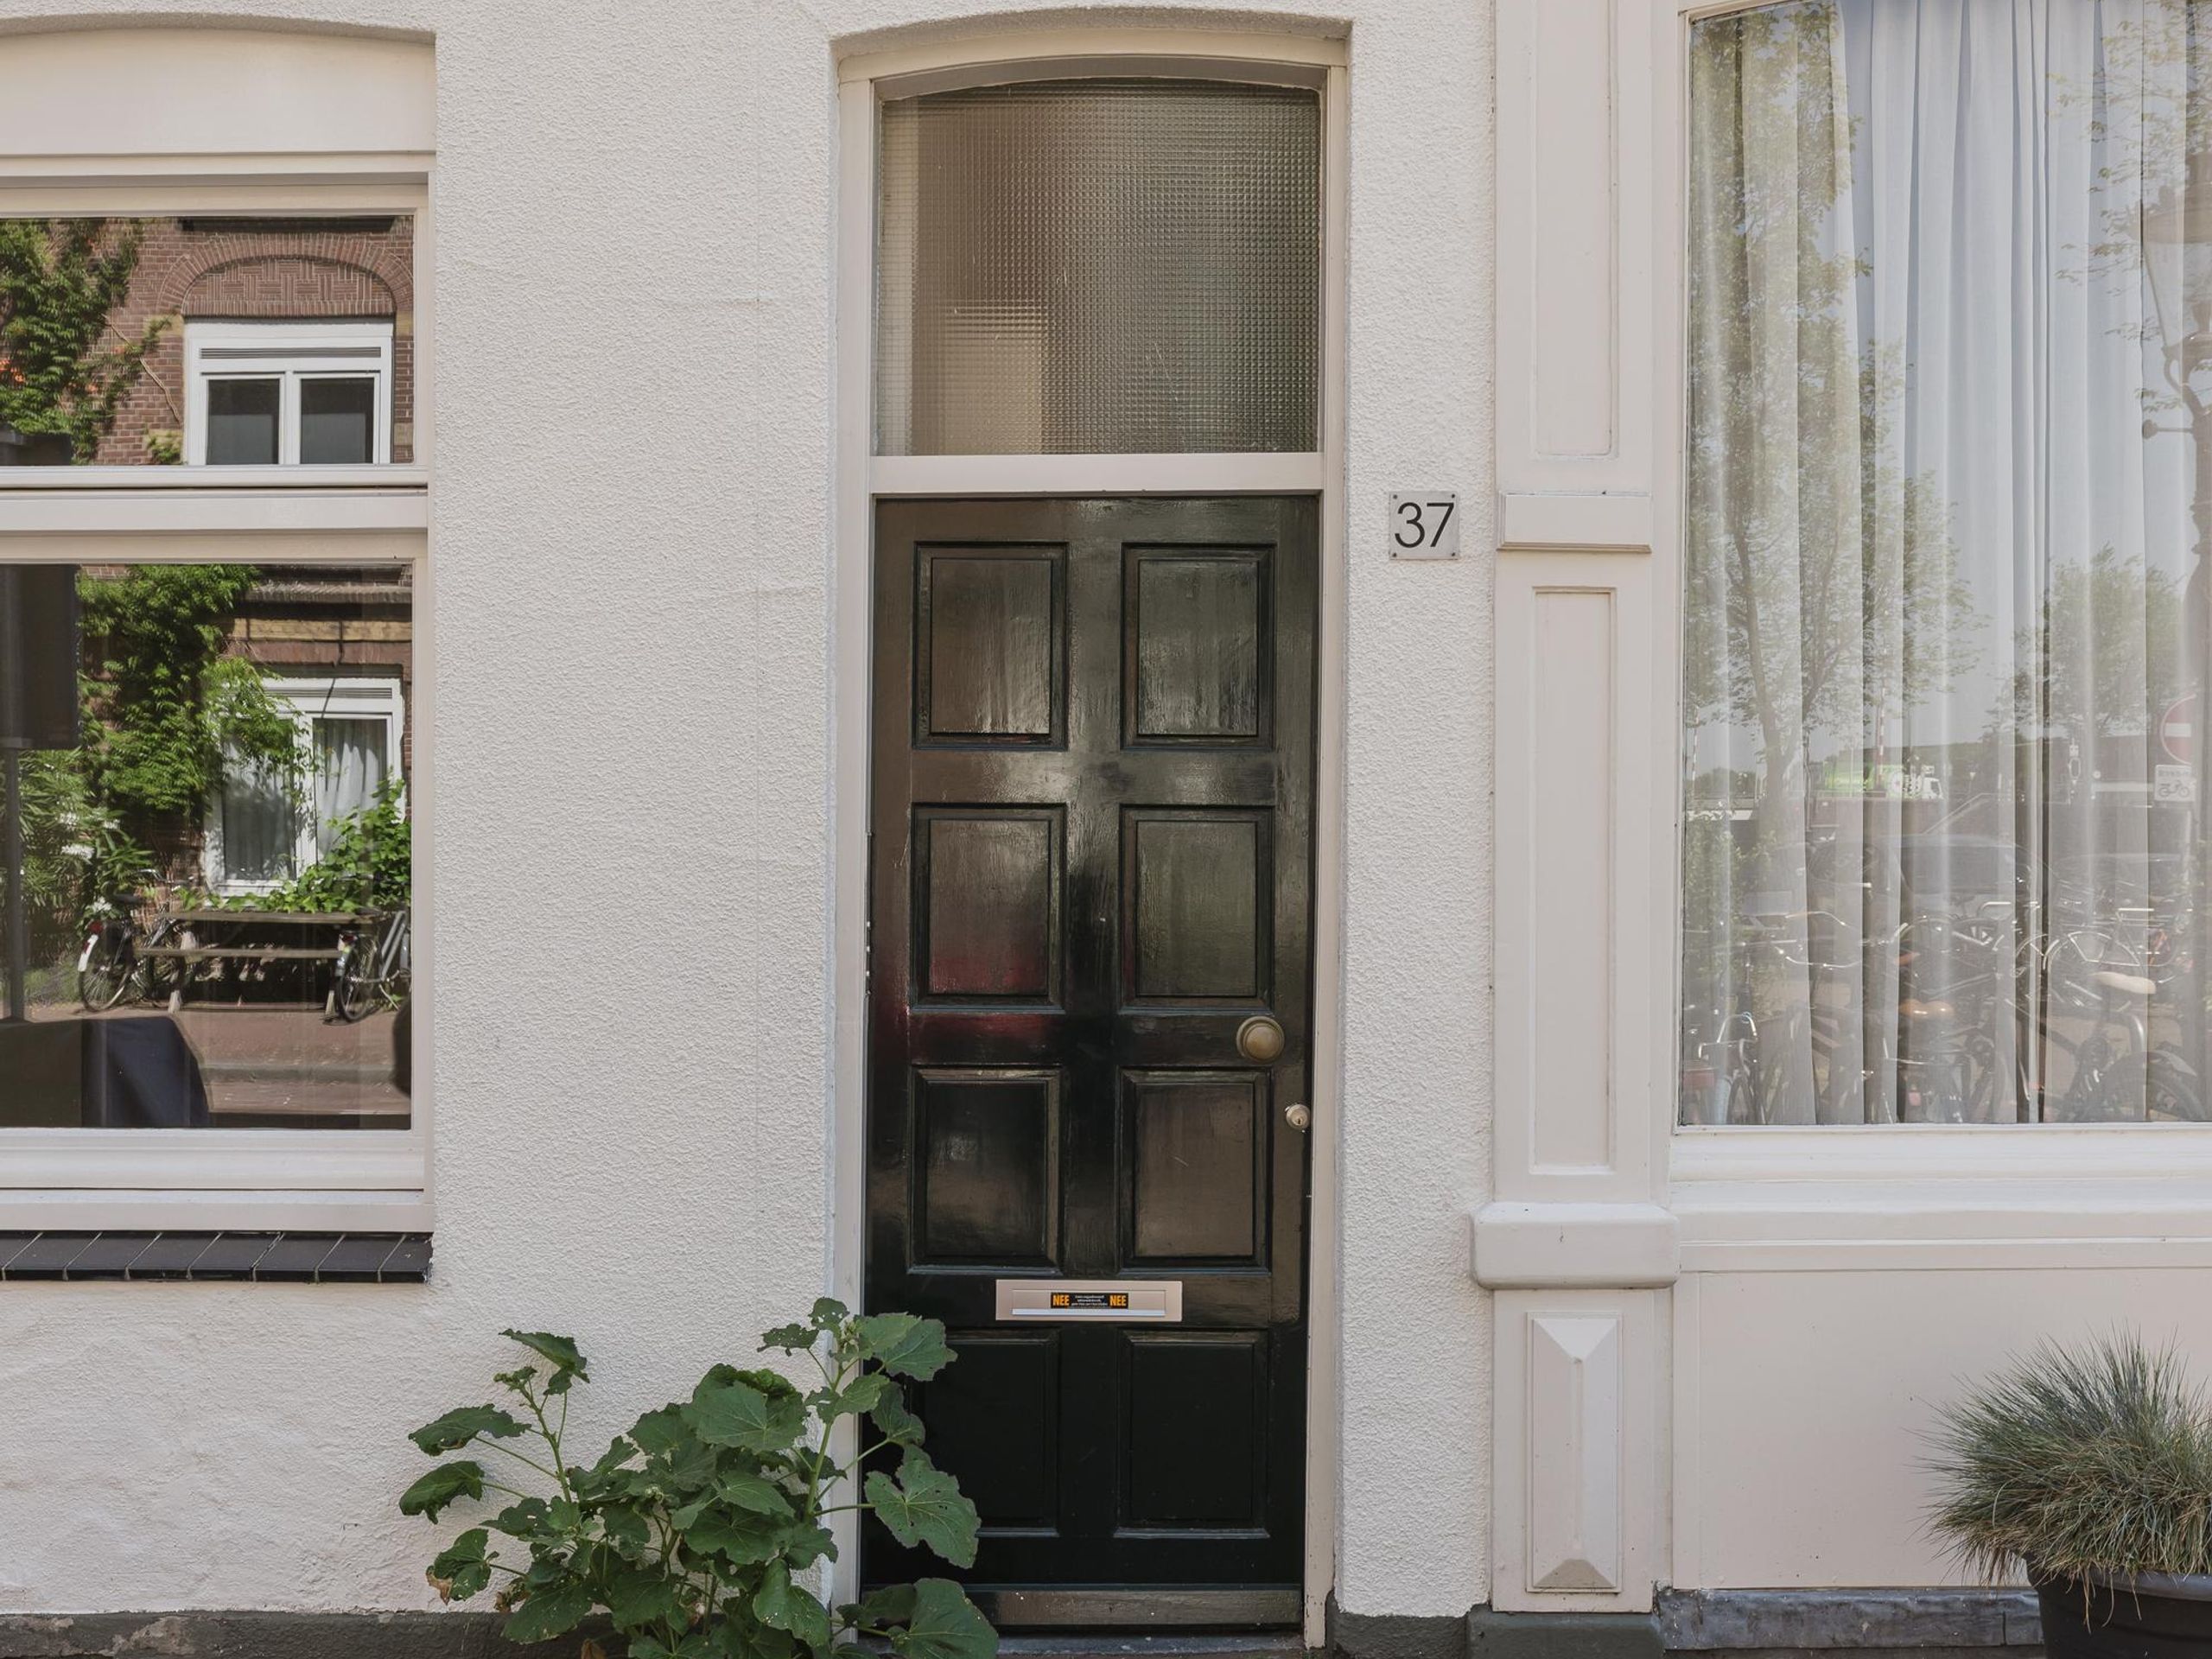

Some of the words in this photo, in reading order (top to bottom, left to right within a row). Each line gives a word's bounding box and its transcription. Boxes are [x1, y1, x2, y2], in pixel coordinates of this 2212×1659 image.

[1395, 502, 1454, 548] 37
[1052, 1295, 1070, 1306] NEE
[1109, 1295, 1127, 1306] NEE
